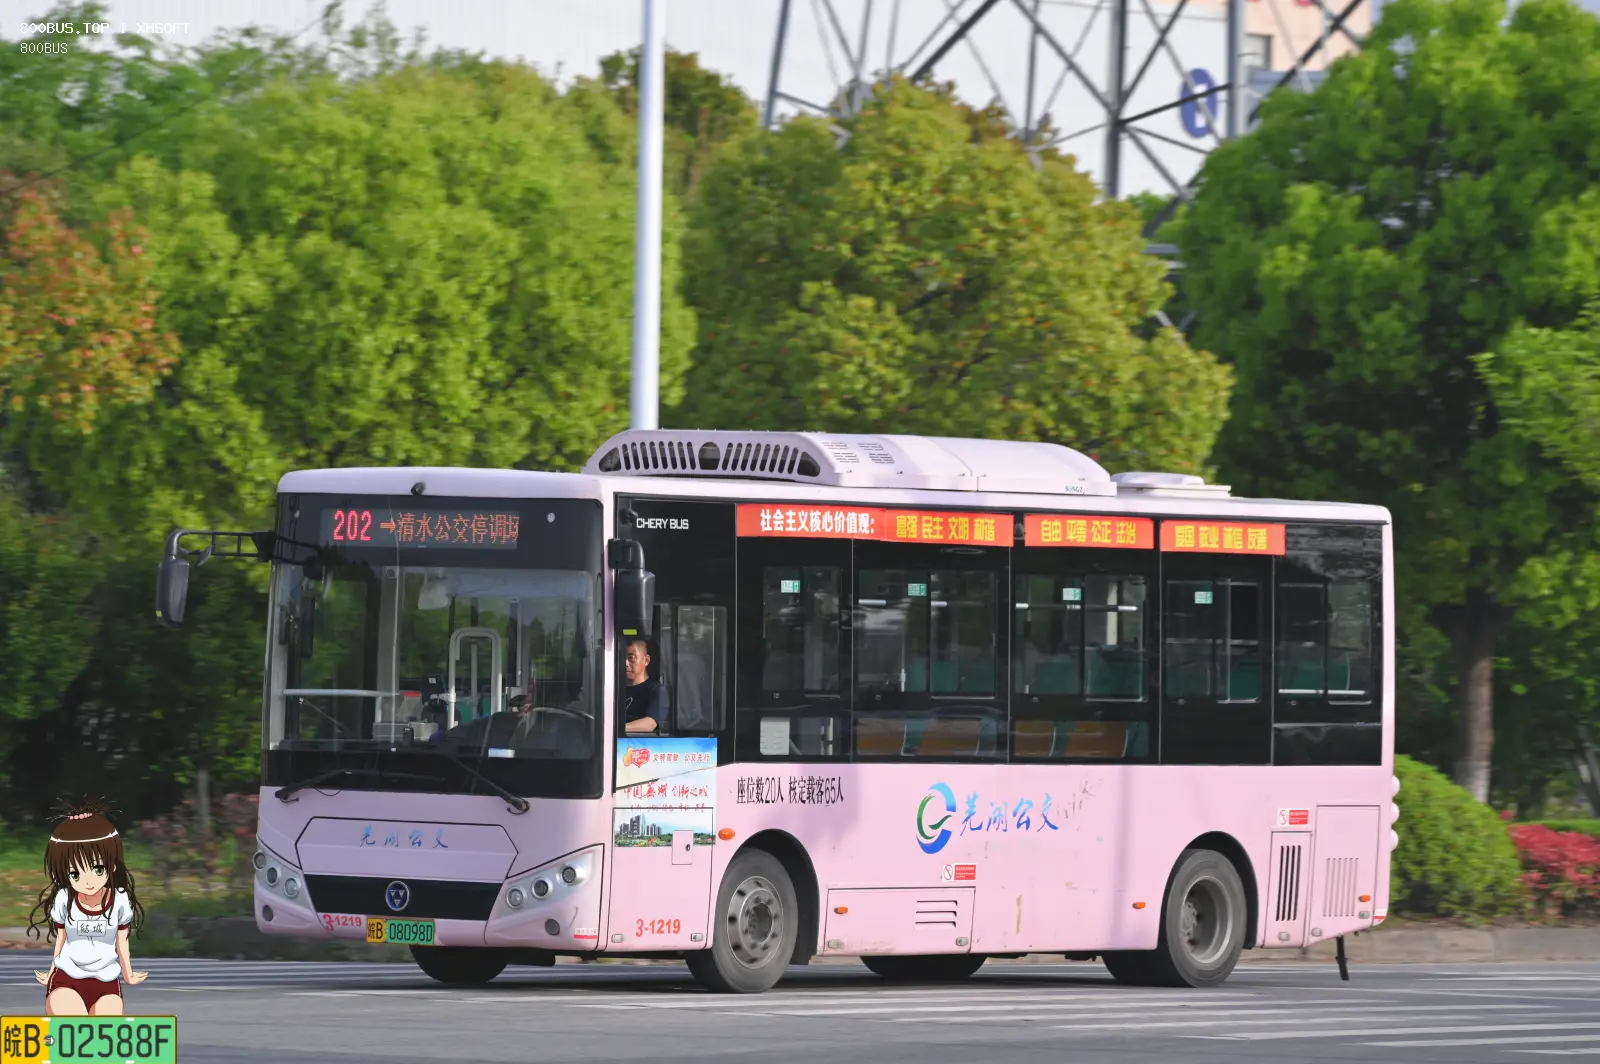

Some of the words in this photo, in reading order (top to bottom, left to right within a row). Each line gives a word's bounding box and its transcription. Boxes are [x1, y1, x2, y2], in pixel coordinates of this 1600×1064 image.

[332, 510, 373, 541] 202
[636, 518, 668, 529] CHERY
[669, 518, 690, 530] BUS
[759, 508, 876, 535] 社会主义核心价值观:
[921, 515, 945, 540] 民主
[947, 516, 970, 541] 文明
[1040, 519, 1063, 543] 自由
[1090, 520, 1113, 544] 公正
[736, 776, 784, 805] 座位数20人
[788, 775, 845, 805] 核定载客65人
[322, 912, 362, 932] 3-1219
[389, 922, 434, 942] 08098D
[635, 918, 682, 938] 3-1219
